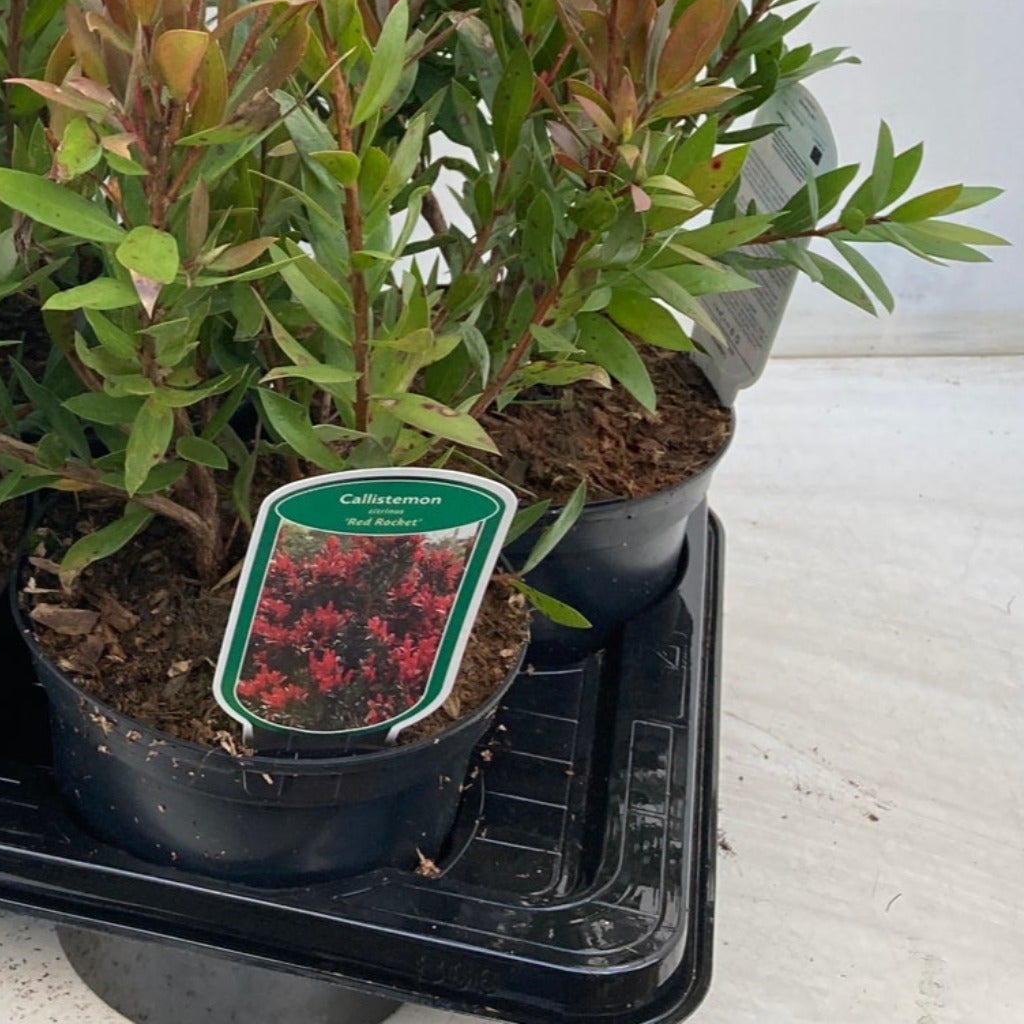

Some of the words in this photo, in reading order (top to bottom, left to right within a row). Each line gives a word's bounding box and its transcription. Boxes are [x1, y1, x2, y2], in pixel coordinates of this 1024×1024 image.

[339, 493, 442, 505] Callistemon
[345, 517, 373, 526] 'Red
[374, 517, 423, 526] Rocket'
